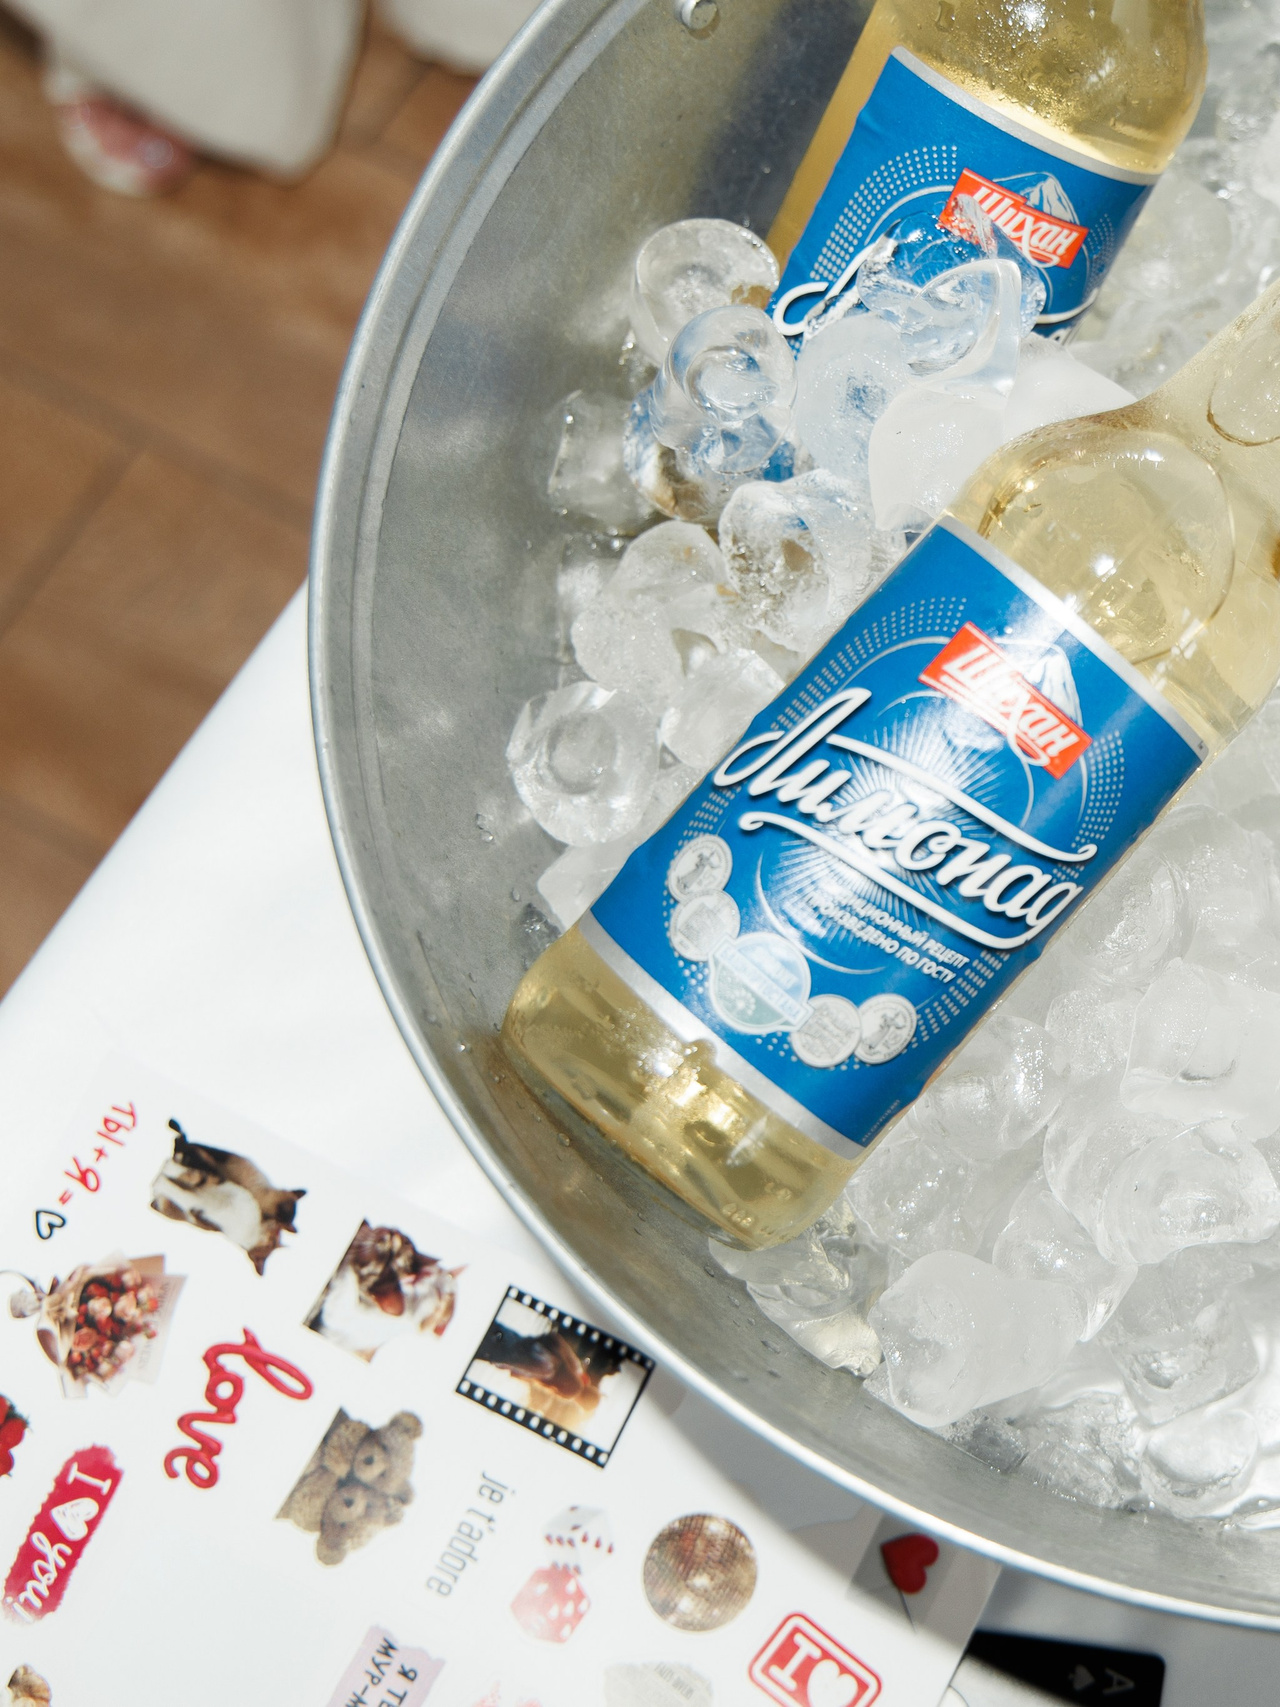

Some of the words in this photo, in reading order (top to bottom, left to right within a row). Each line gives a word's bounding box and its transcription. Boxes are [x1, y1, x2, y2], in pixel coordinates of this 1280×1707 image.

[895, 946, 920, 966] ПО
[917, 957, 957, 984] ГОСТУ
[923, 938, 970, 969] РЕЦЕПТ
[64, 1156, 100, 1192] Я
[163, 1326, 314, 1490] love
[478, 1470, 516, 1504] je
[425, 1507, 496, 1597] t'adore
[344, 1636, 399, 1707] МУР-М
[397, 1663, 418, 1682] Я
